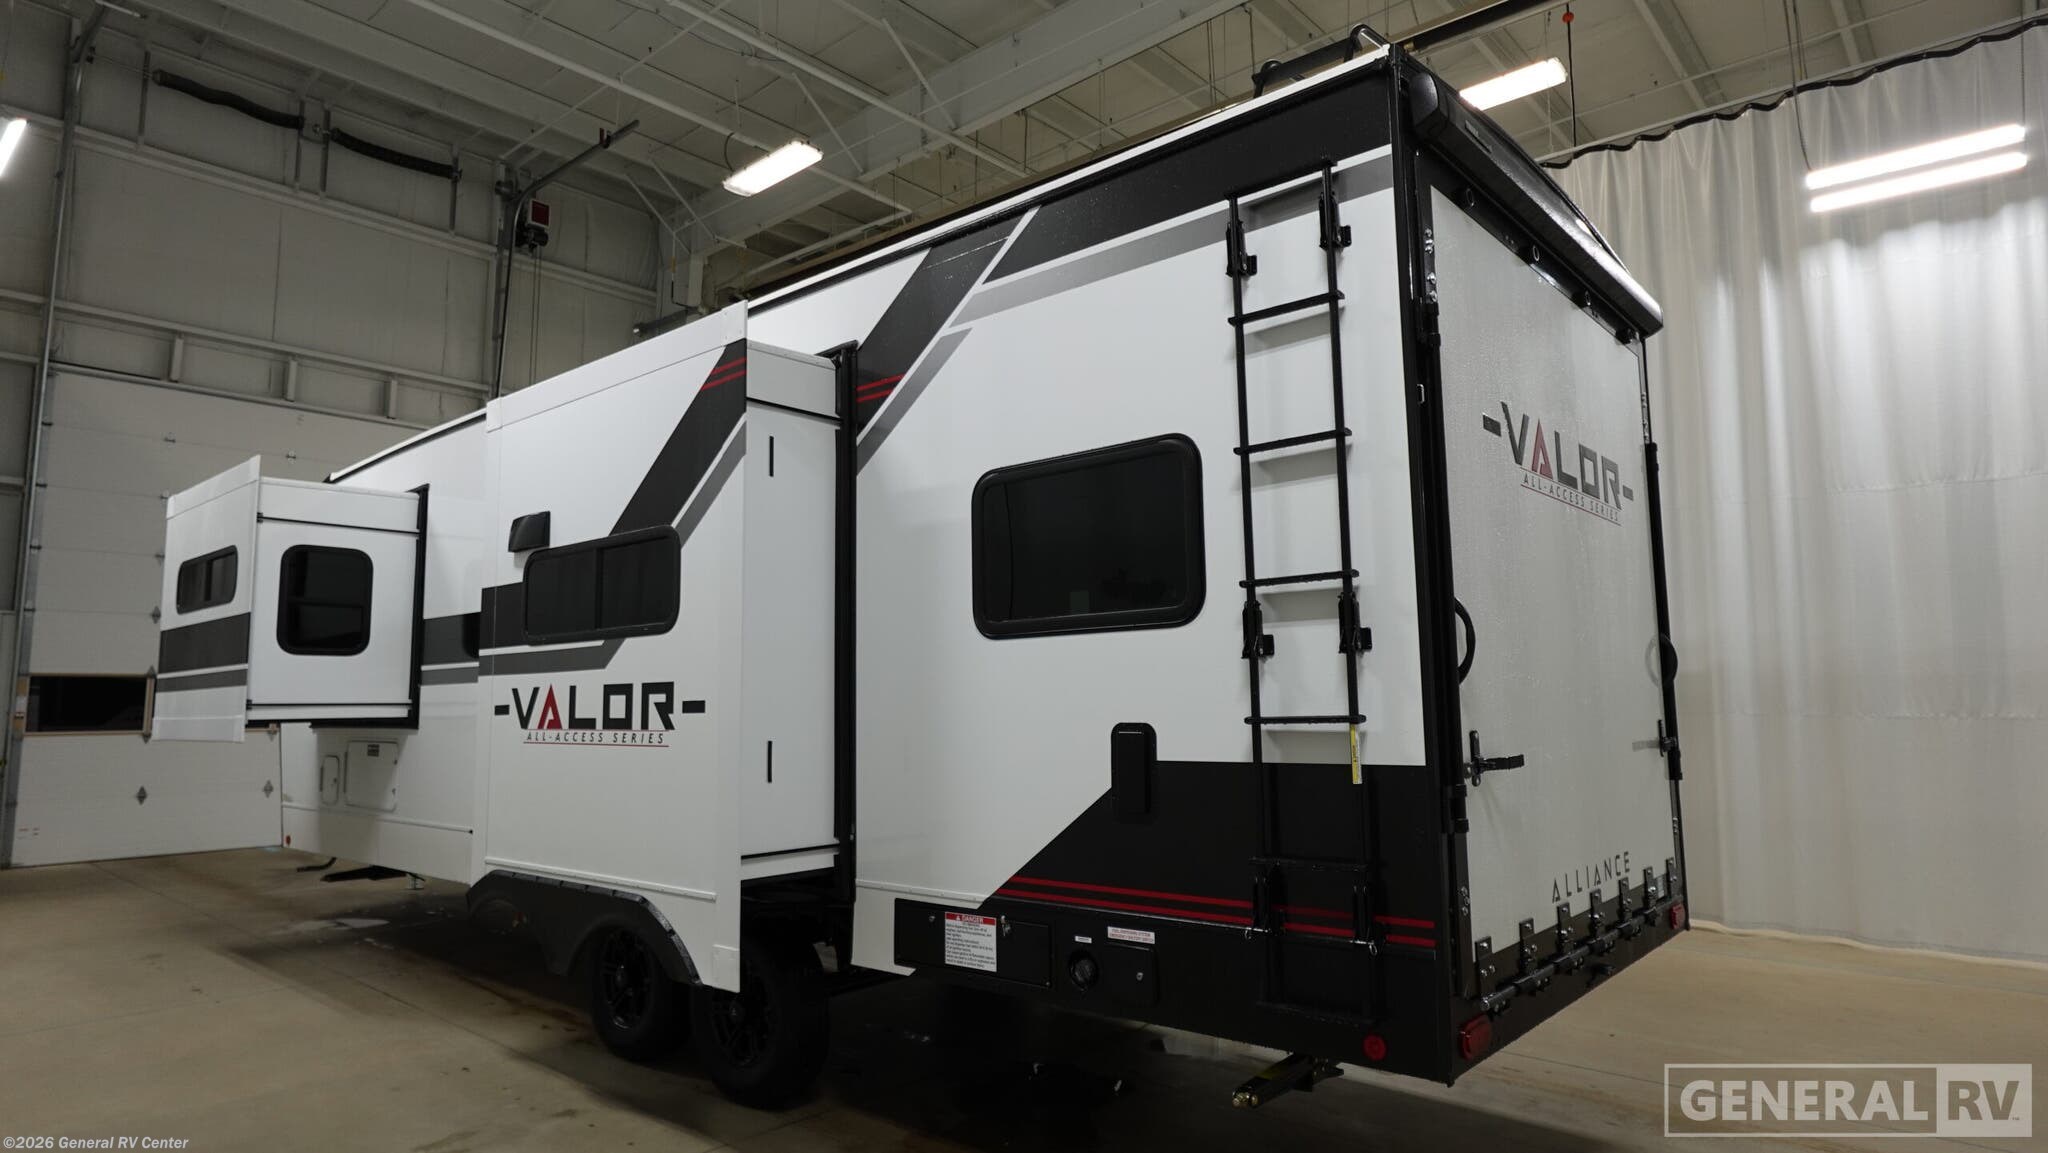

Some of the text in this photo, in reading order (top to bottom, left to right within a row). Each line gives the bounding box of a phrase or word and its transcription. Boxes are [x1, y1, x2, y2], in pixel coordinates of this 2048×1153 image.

[1523, 472, 1619, 522] ALL-ACCESS SERIES
[526, 732, 664, 744] ALL-ACCESS SERIES
[1551, 851, 1630, 904] ALLIANCE
[962, 915, 984, 924] DANGER
